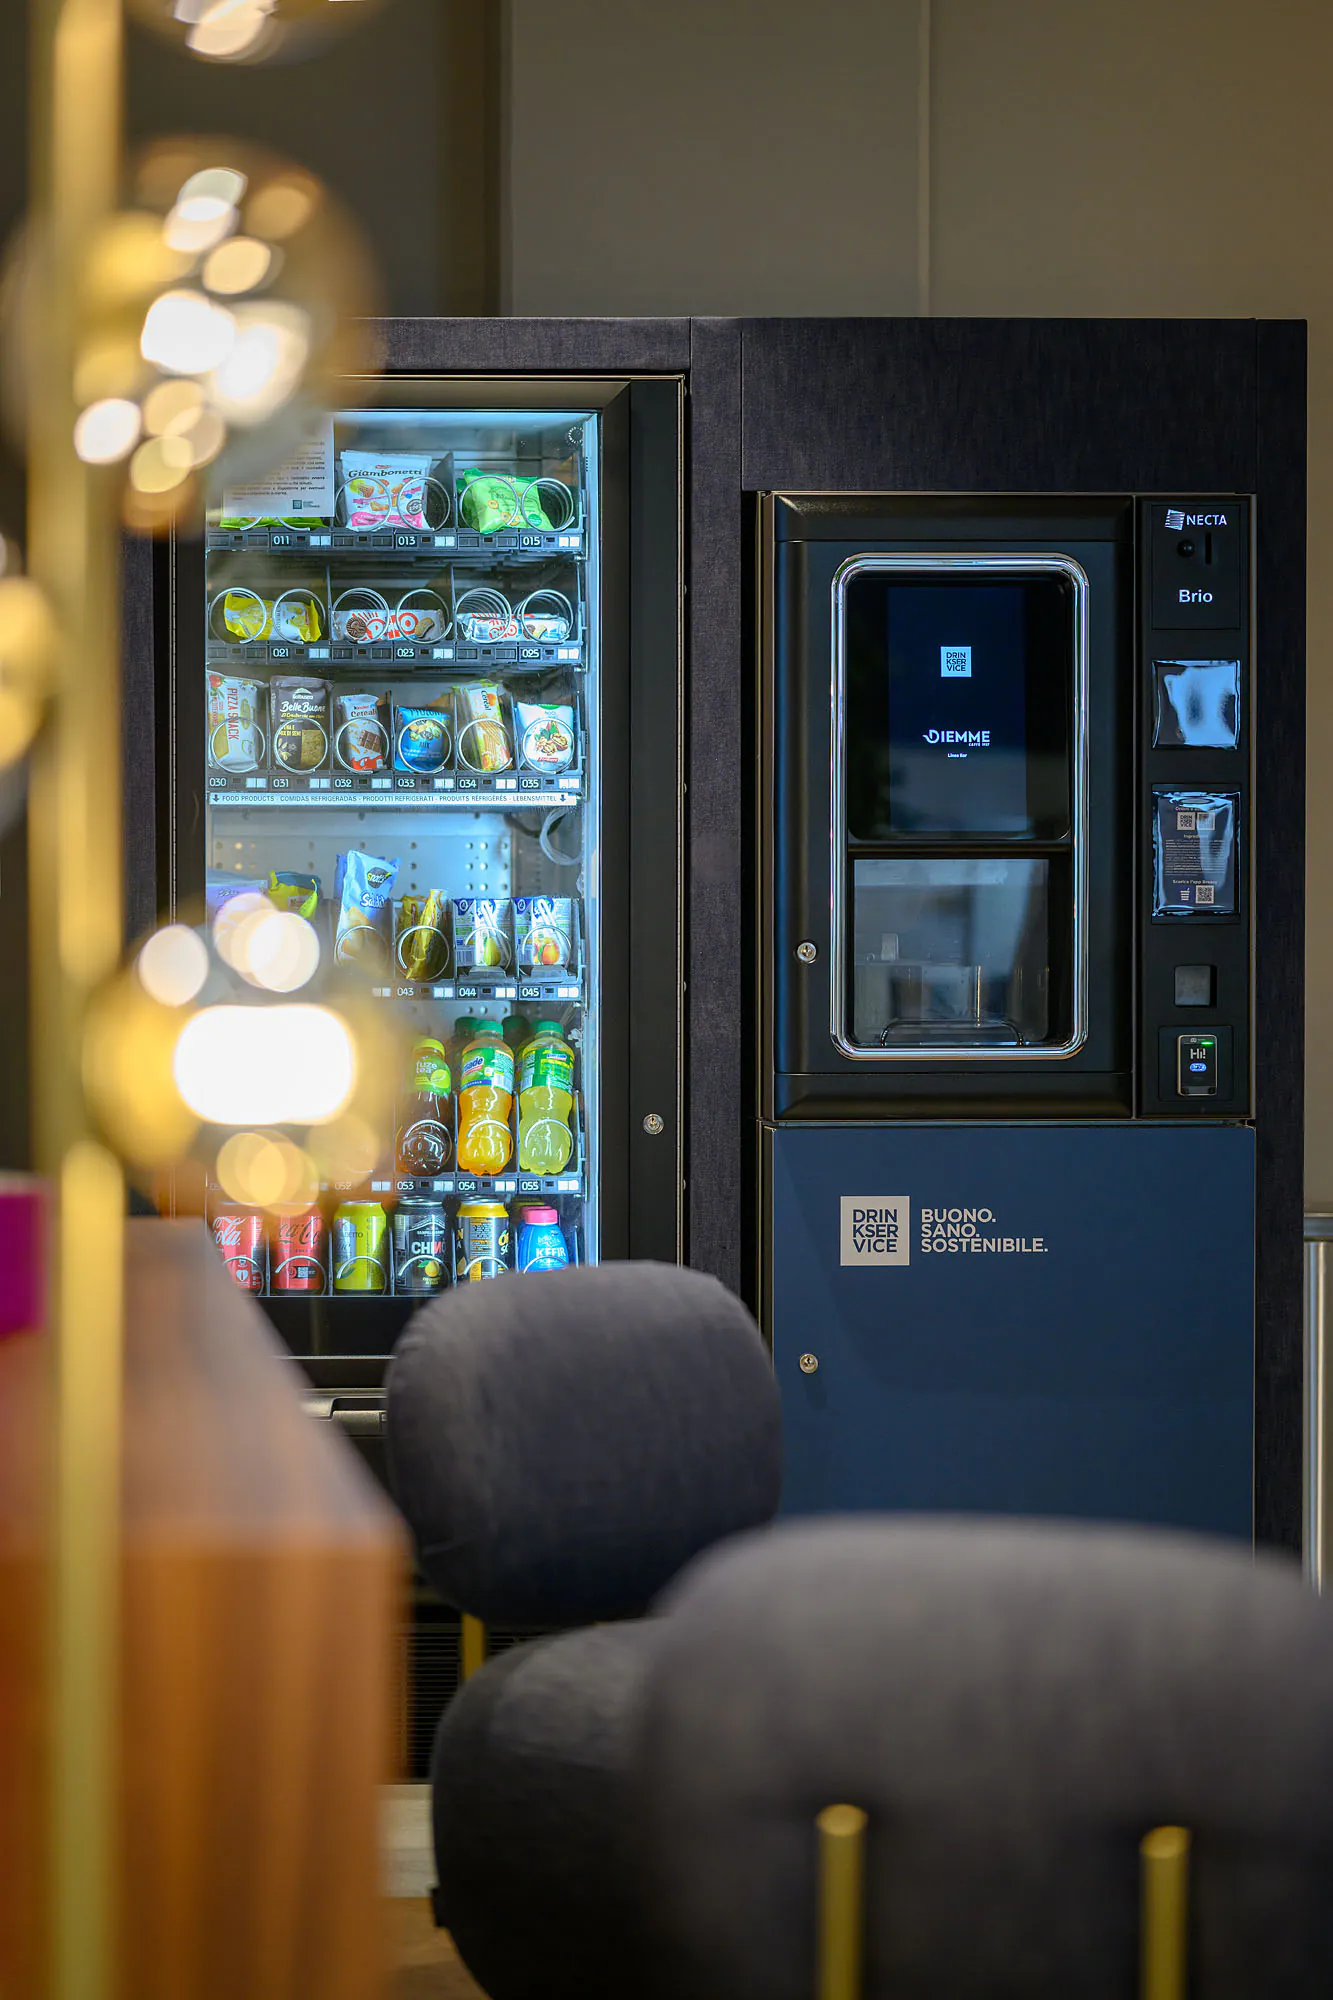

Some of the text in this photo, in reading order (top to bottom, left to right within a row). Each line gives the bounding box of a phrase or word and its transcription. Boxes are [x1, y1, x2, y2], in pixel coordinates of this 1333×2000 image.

[348, 469, 423, 478] Giambonetti
[1186, 514, 1228, 526] NECTA
[273, 535, 290, 545] 011
[398, 536, 416, 546] 013
[522, 536, 541, 546] 015
[1178, 588, 1214, 603] Brio
[272, 648, 289, 658] 021
[397, 648, 415, 658] 023
[521, 648, 540, 658] 025
[227, 687, 238, 711] PIZZA
[922, 729, 991, 743] DIEMME
[209, 778, 227, 787] 030
[273, 779, 289, 788] 031
[335, 779, 352, 788] 032
[397, 778, 415, 788] 033
[459, 779, 477, 788] 034
[521, 779, 540, 788] 035
[397, 987, 414, 997] 043
[459, 988, 477, 998] 044
[521, 988, 540, 998] 045
[1190, 1048, 1206, 1060] Hi!
[397, 1181, 414, 1191] 053
[458, 1181, 476, 1191] 054
[521, 1181, 539, 1191] 055
[852, 1208, 898, 1223] DRIN
[921, 1208, 997, 1223] BUONO.
[852, 1223, 899, 1238] KSER
[920, 1223, 981, 1238] SANO.
[852, 1238, 898, 1253] VICE
[920, 1238, 1049, 1253] SOSTENIBILE.
[535, 1247, 567, 1258] KEFIR
